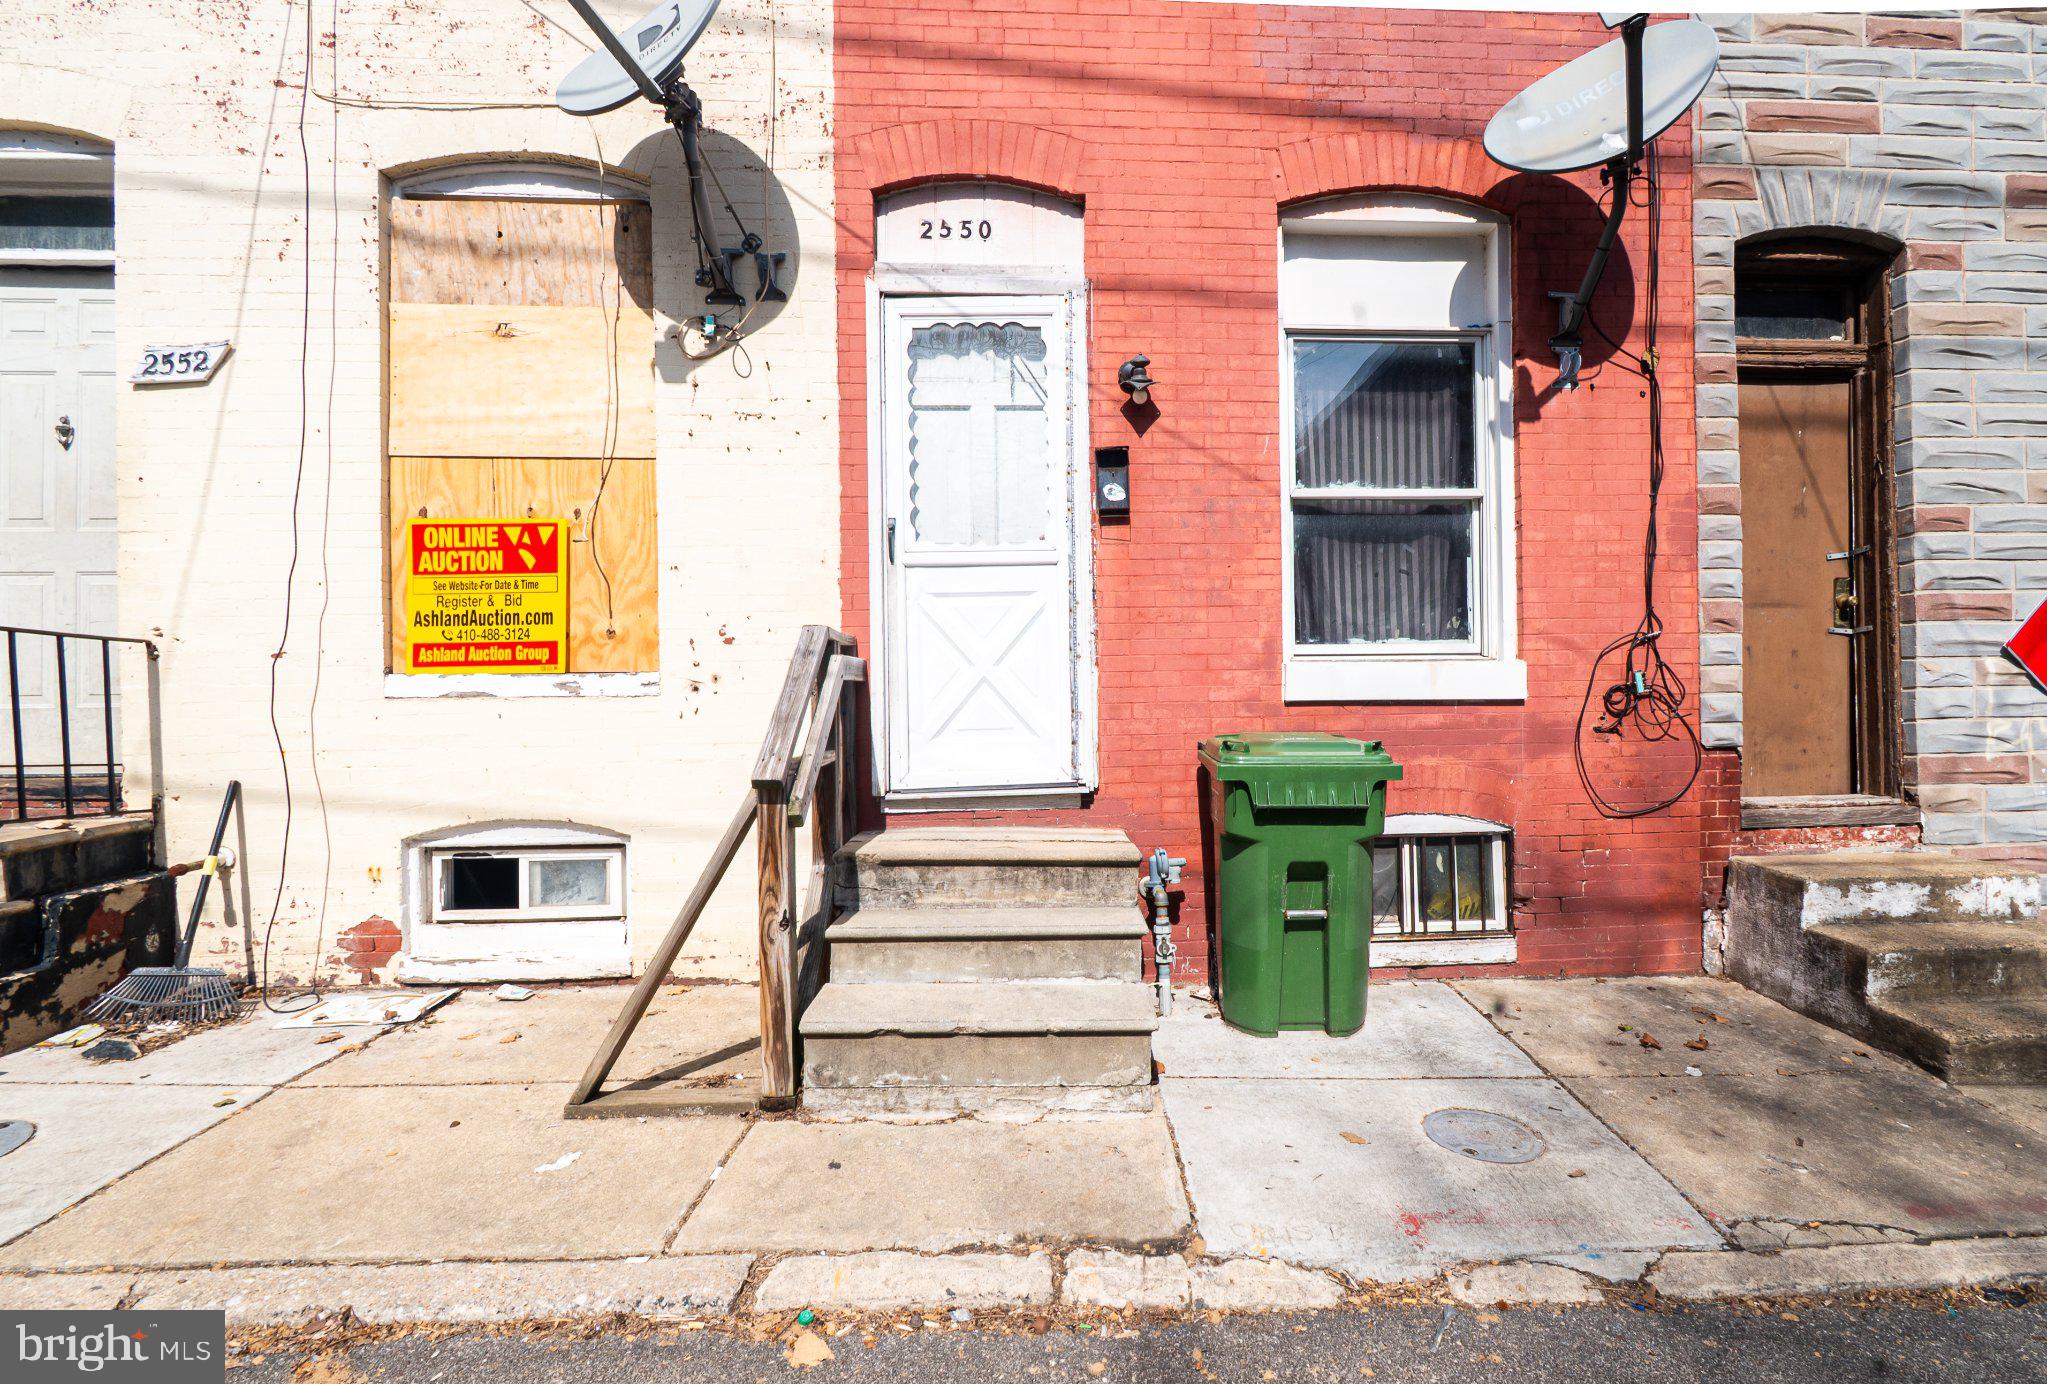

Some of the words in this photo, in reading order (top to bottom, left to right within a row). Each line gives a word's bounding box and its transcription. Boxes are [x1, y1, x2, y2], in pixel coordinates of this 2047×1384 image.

[639, 24, 681, 61] DIRECTV
[1555, 68, 1626, 117] DIREC
[920, 219, 992, 240] 2550
[142, 350, 209, 377] 2552
[423, 526, 499, 548] ONLINE
[418, 550, 504, 573] AUCTION
[433, 581, 446, 591] See
[449, 580, 479, 591] Website
[481, 580, 493, 590] For
[494, 580, 512, 590] Date
[513, 580, 520, 589] &
[521, 579, 539, 590] Time
[436, 595, 483, 611] Register
[486, 595, 495, 607] &
[504, 594, 523, 607] Bid
[413, 609, 554, 628] AshlandAuction.com
[456, 628, 531, 641] 410-488-3124
[418, 647, 465, 663] Ashland
[468, 646, 512, 662] Auction
[515, 645, 550, 663] Group
